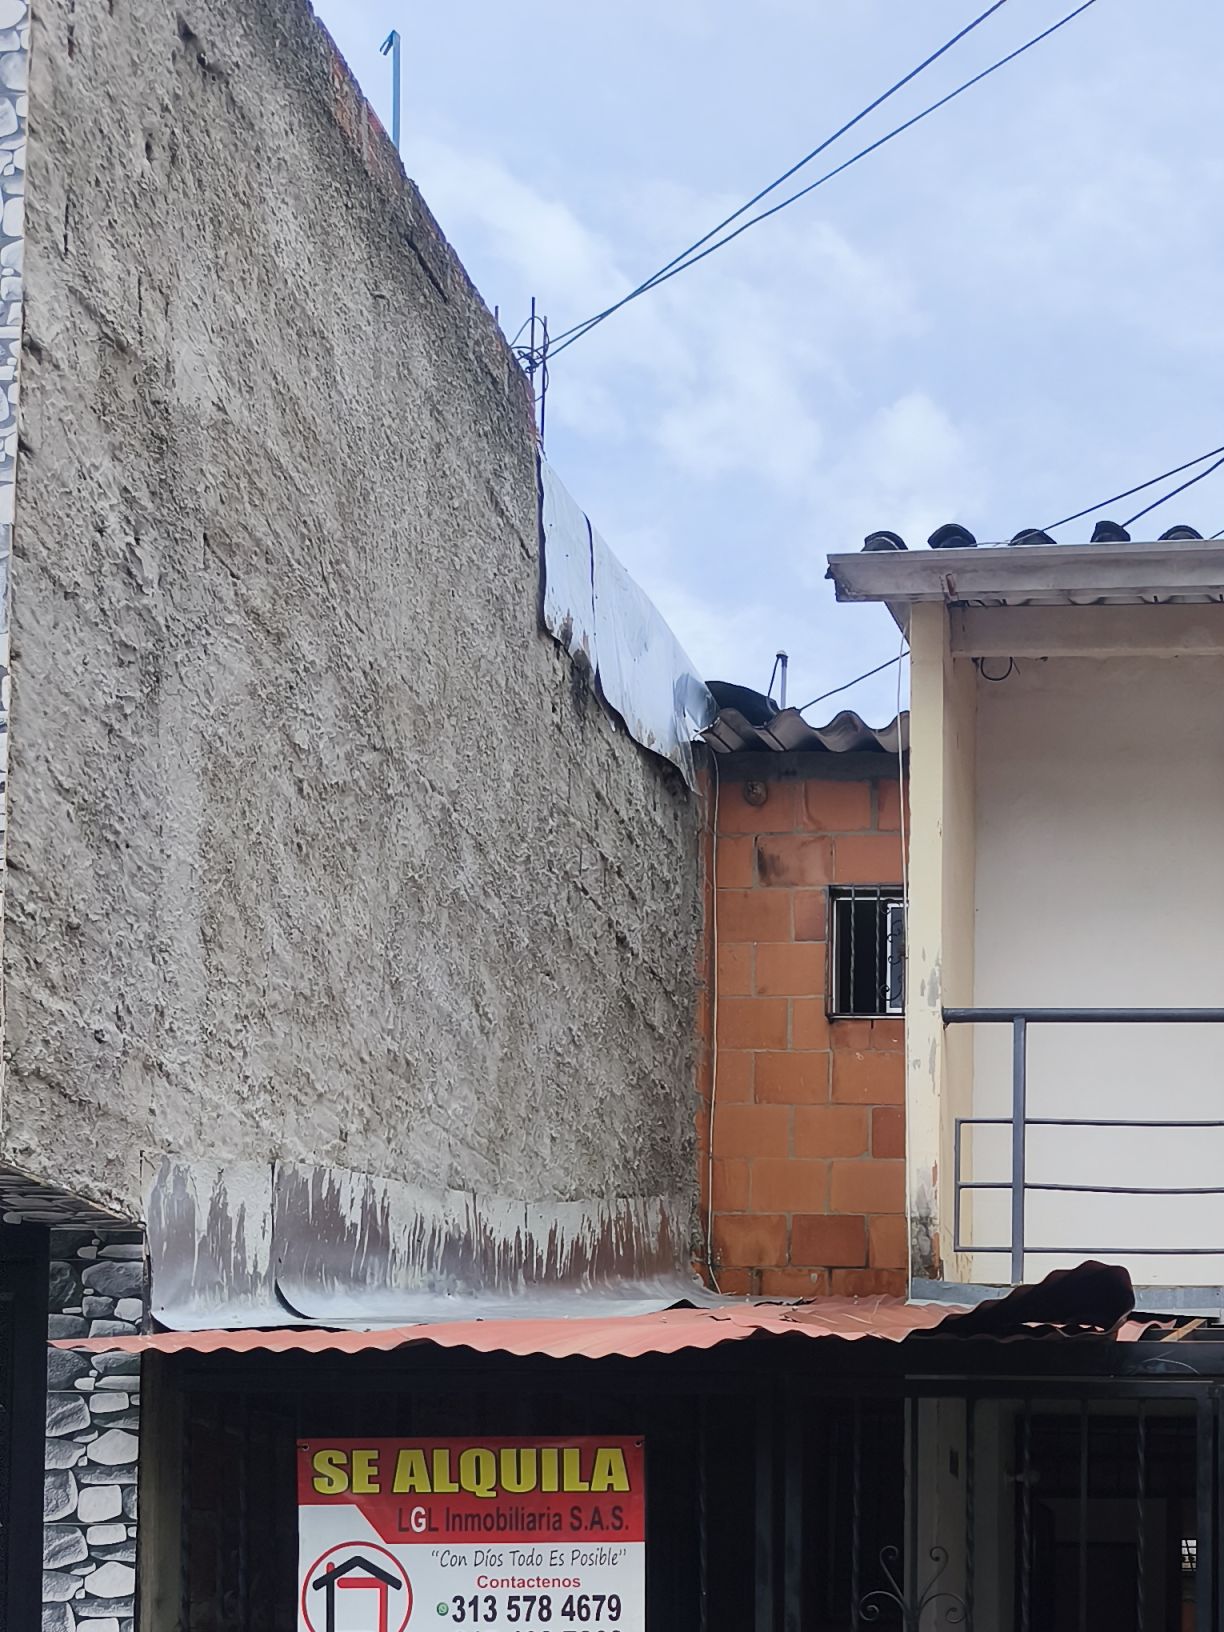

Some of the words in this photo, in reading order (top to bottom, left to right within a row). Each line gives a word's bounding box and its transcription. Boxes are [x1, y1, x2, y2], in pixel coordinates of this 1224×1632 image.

[312, 1449, 381, 1494] SE
[392, 1447, 631, 1498] ALQUILA
[397, 1506, 438, 1533] LGL
[446, 1507, 562, 1532] Inmobiliaria
[569, 1505, 629, 1531] S.A.S.
[509, 1548, 543, 1567] Todo
[550, 1549, 565, 1567] Es
[477, 1575, 581, 1590] Contactenos
[452, 1595, 498, 1623] 313
[506, 1595, 552, 1622] 578
[561, 1594, 622, 1622] 4679
